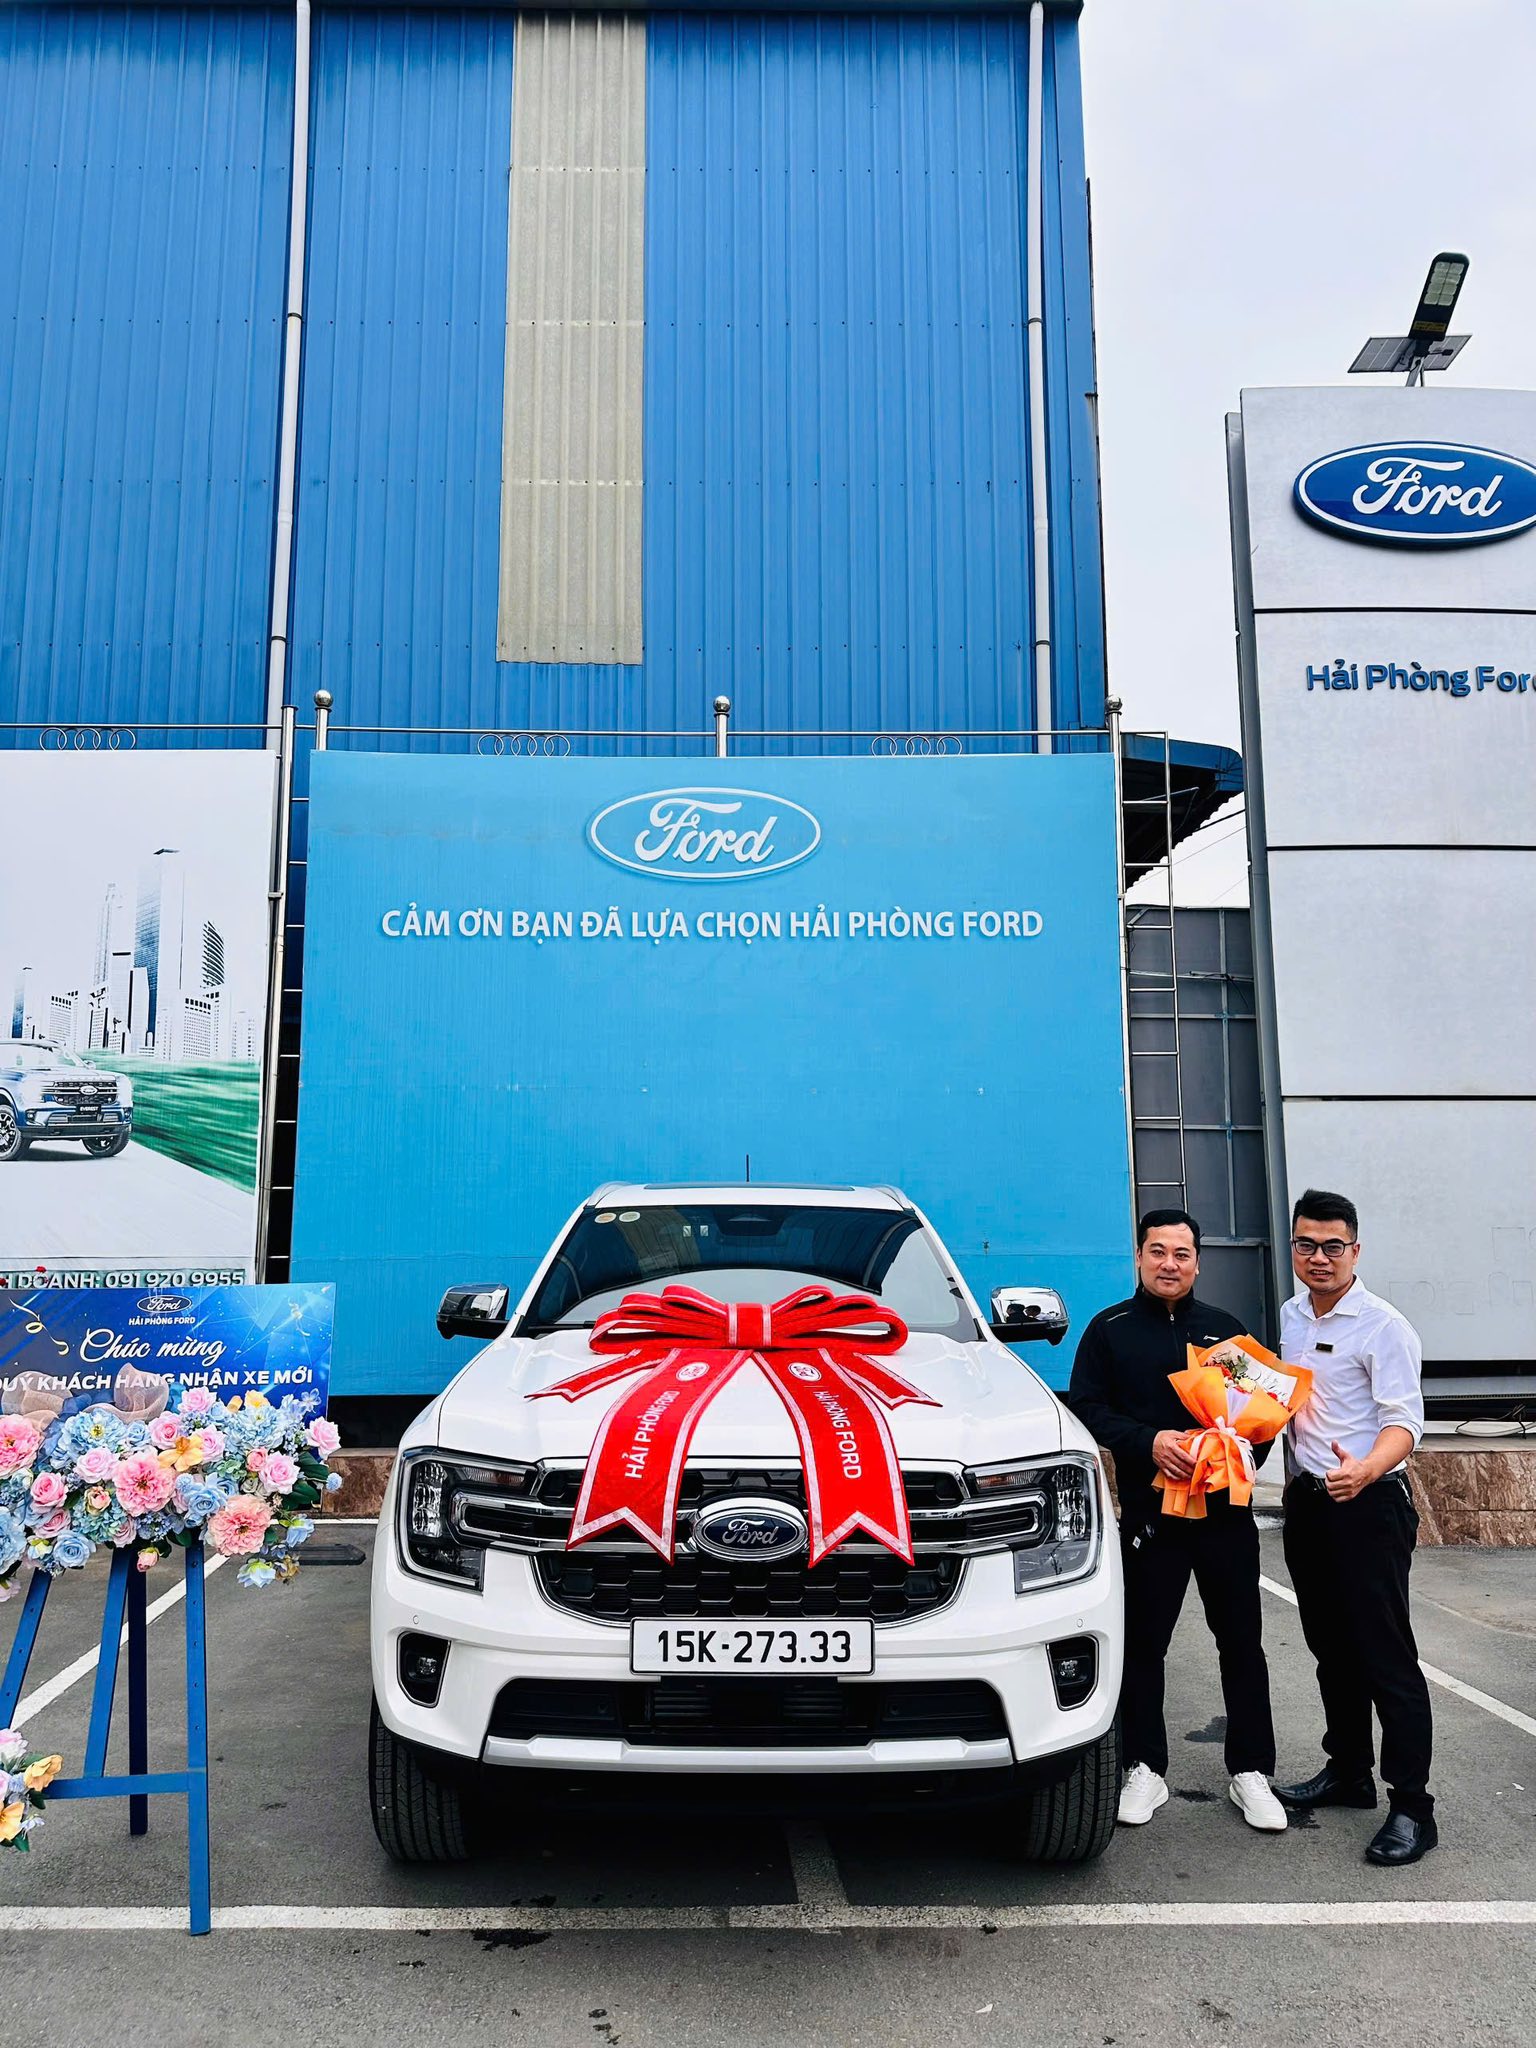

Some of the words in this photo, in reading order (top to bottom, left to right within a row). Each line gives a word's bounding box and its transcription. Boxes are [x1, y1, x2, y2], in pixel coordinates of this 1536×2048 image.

[1352, 457, 1504, 517] Ford
[1306, 659, 1358, 690] Hải
[1365, 661, 1471, 697] Phòng
[634, 798, 778, 862] Ford
[382, 902, 450, 937] CẢM
[458, 908, 503, 937] ƠN
[512, 911, 573, 945] BẠN
[580, 906, 624, 937] ĐÃ
[632, 908, 689, 945] LỰA
[696, 911, 780, 945] CHỌN
[790, 904, 840, 937] HẢI
[848, 906, 955, 937] PHÒNG
[963, 911, 1043, 937] FORD
[18, 1273, 100, 1289] DOANH:
[105, 1272, 140, 1288] 091
[146, 1272, 185, 1287] 920
[191, 1271, 244, 1286] 9955
[128, 1316, 143, 1326] HẢI
[144, 1315, 173, 1326] PHÒNG
[173, 1317, 196, 1325] FORD
[147, 1297, 182, 1310] Ford
[79, 1328, 151, 1362] Chúc
[156, 1336, 227, 1366] mừng
[0, 1373, 34, 1392] UÝ
[37, 1371, 111, 1391] KHÁCH
[179, 1368, 239, 1389] NHẬN
[241, 1372, 270, 1385] XE
[273, 1366, 313, 1384] MỚI
[634, 1403, 669, 1443] PHÒNG
[821, 1402, 851, 1429] PHÒNG
[836, 1431, 862, 1480] FORD
[621, 1446, 650, 1479] HẢI
[722, 1518, 779, 1545] Ford
[658, 1630, 851, 1663] 15K-273.33
